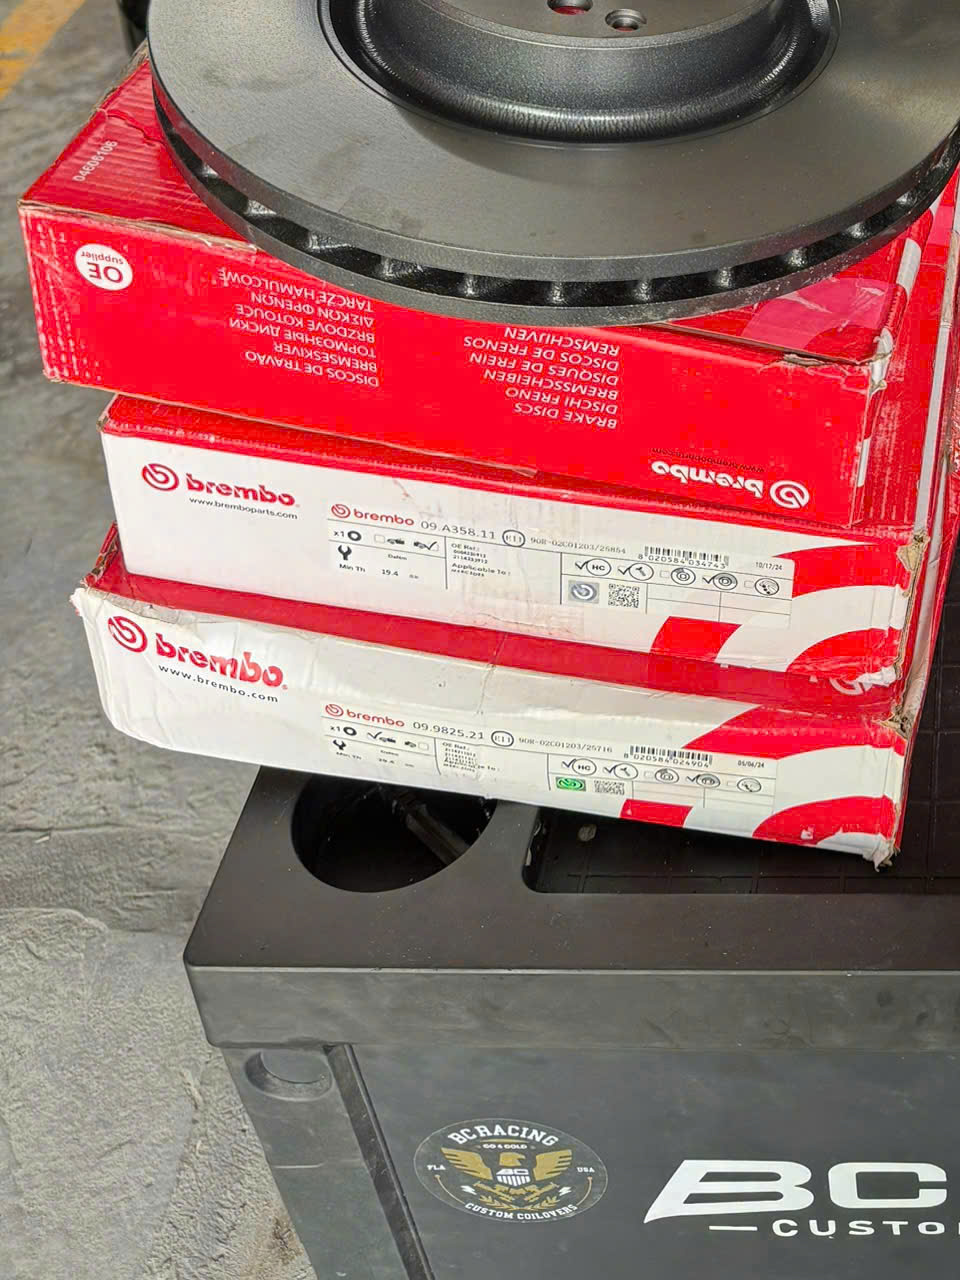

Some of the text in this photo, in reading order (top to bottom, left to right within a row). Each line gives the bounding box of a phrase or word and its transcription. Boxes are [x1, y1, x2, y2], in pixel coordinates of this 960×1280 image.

[81, 250, 123, 265] supplier
[87, 261, 123, 283] OE
[229, 317, 280, 337] ДИСКИ
[504, 326, 620, 357] REMSCHIJVEN
[274, 341, 377, 373] BREMSESKIVER
[304, 362, 323, 376] DE
[463, 336, 619, 372] DISCOS DE FRENOS
[469, 352, 619, 386] DISQUES DE FREIN
[327, 368, 379, 387] DISCOS
[483, 370, 618, 401] BREMSSCHEIBEN
[505, 387, 618, 415] DISCHI FRENO
[514, 402, 618, 429] BRAKE DISCS
[186, 473, 295, 507] brembo
[651, 460, 764, 499] brembo
[189, 497, 298, 520] www.bremboparts.com
[353, 509, 496, 540] brembo 09.A358.11
[755, 561, 783, 571] 10/17/24
[155, 632, 284, 688] brembo
[158, 664, 279, 704] www.brembo.com
[346, 708, 484, 740] brembo 09.9825.21
[465, 1202, 578, 1220] CUSTOM COILOVERS
